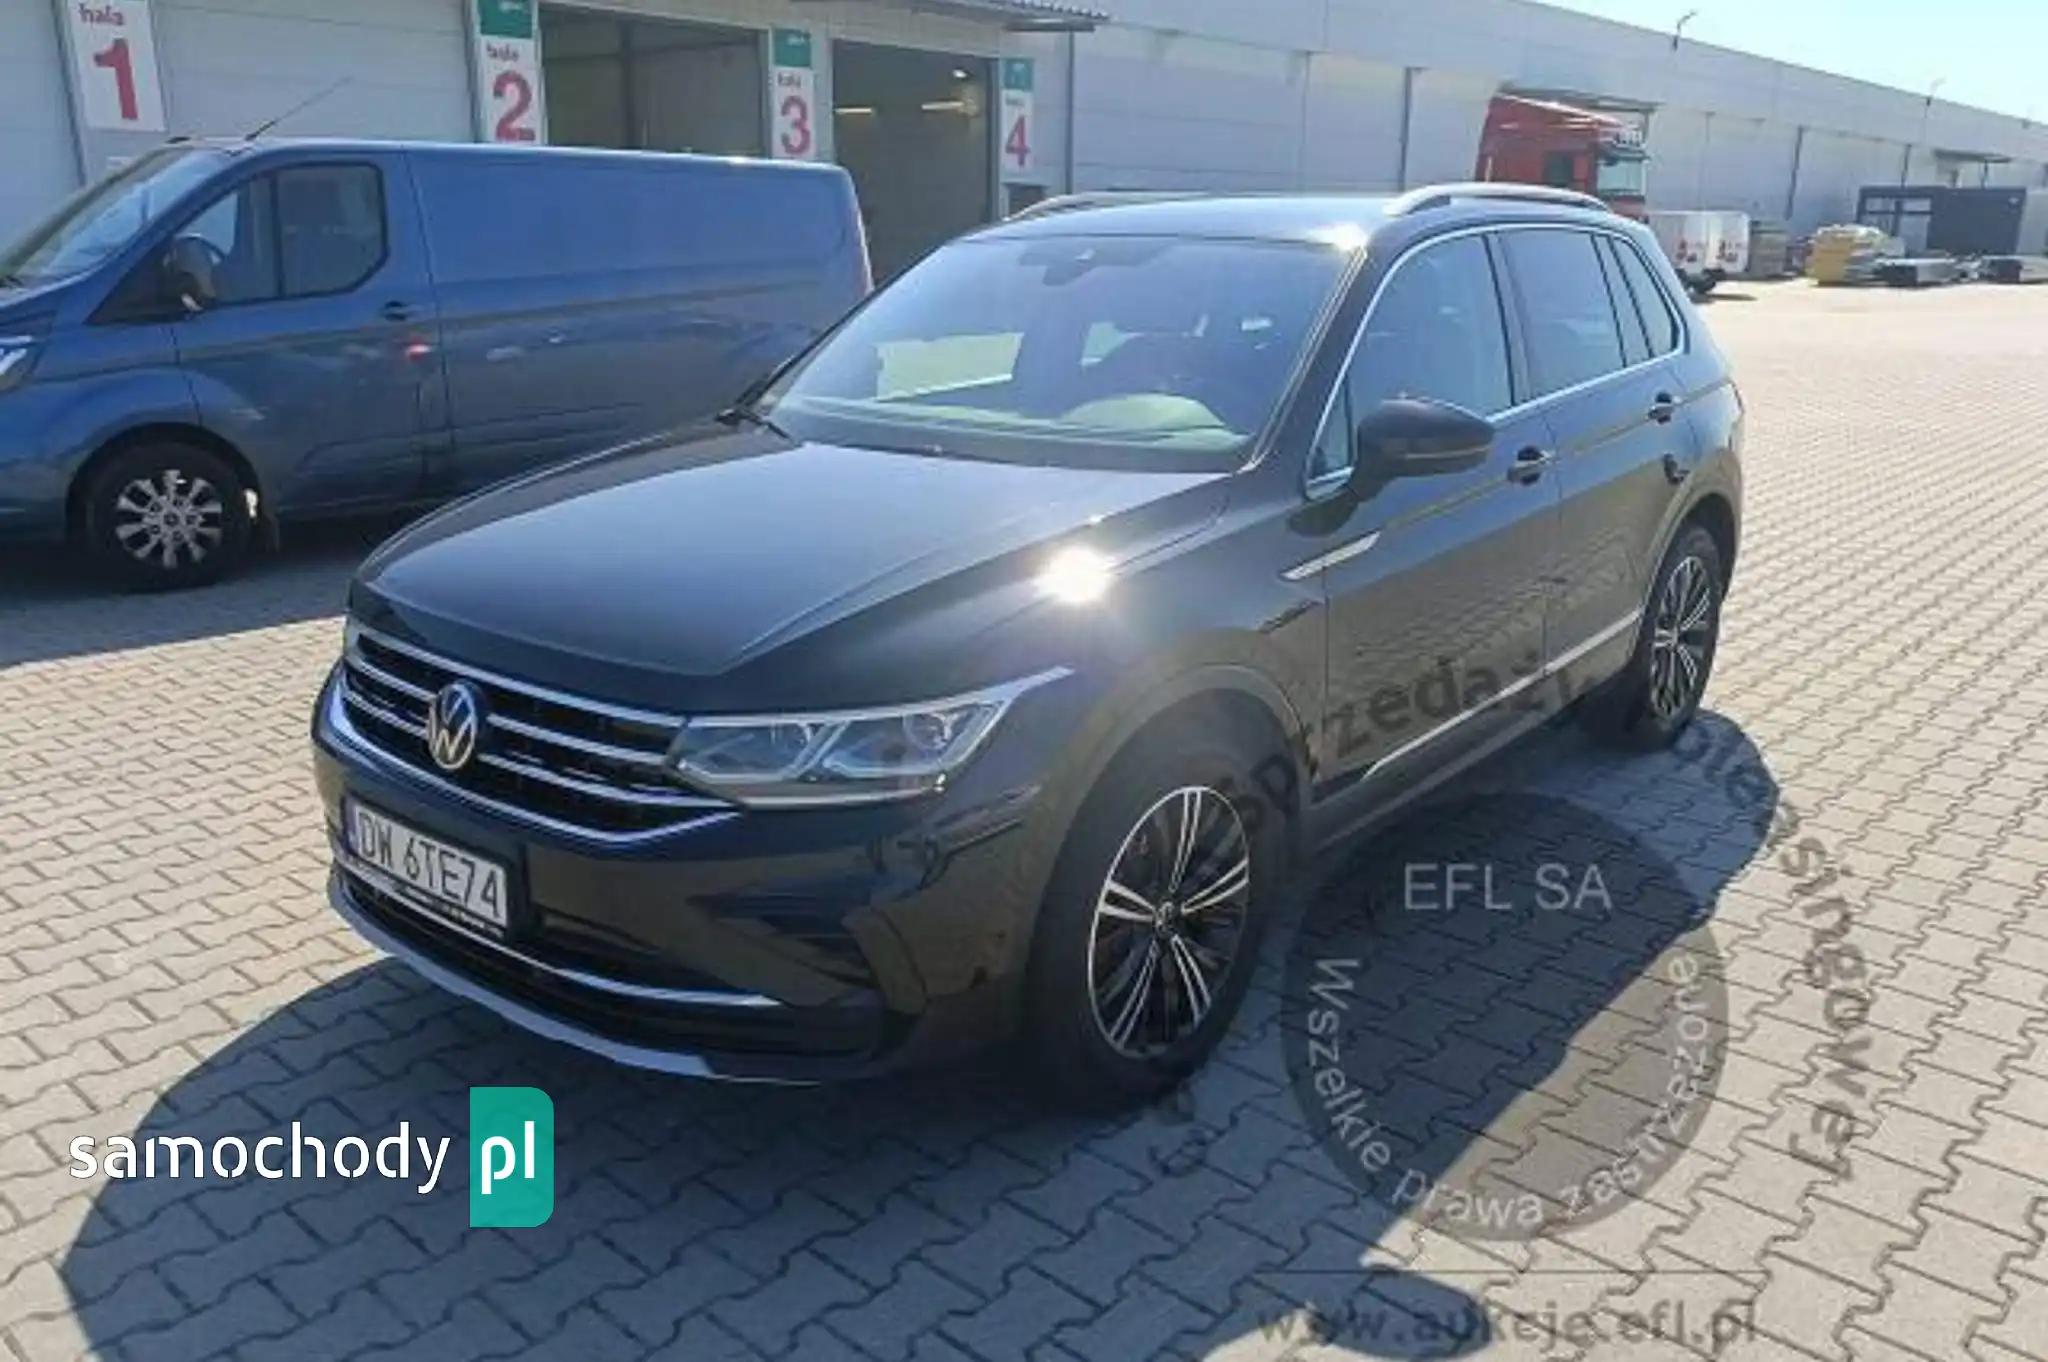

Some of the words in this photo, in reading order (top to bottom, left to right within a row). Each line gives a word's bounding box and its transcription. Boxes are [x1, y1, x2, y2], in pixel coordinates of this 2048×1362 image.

[93, 38, 138, 119] 1
[492, 70, 536, 141] 2
[780, 95, 811, 155] 3
[1005, 115, 1031, 166] 4
[358, 811, 394, 865] DW
[403, 836, 499, 917] 6TE74
